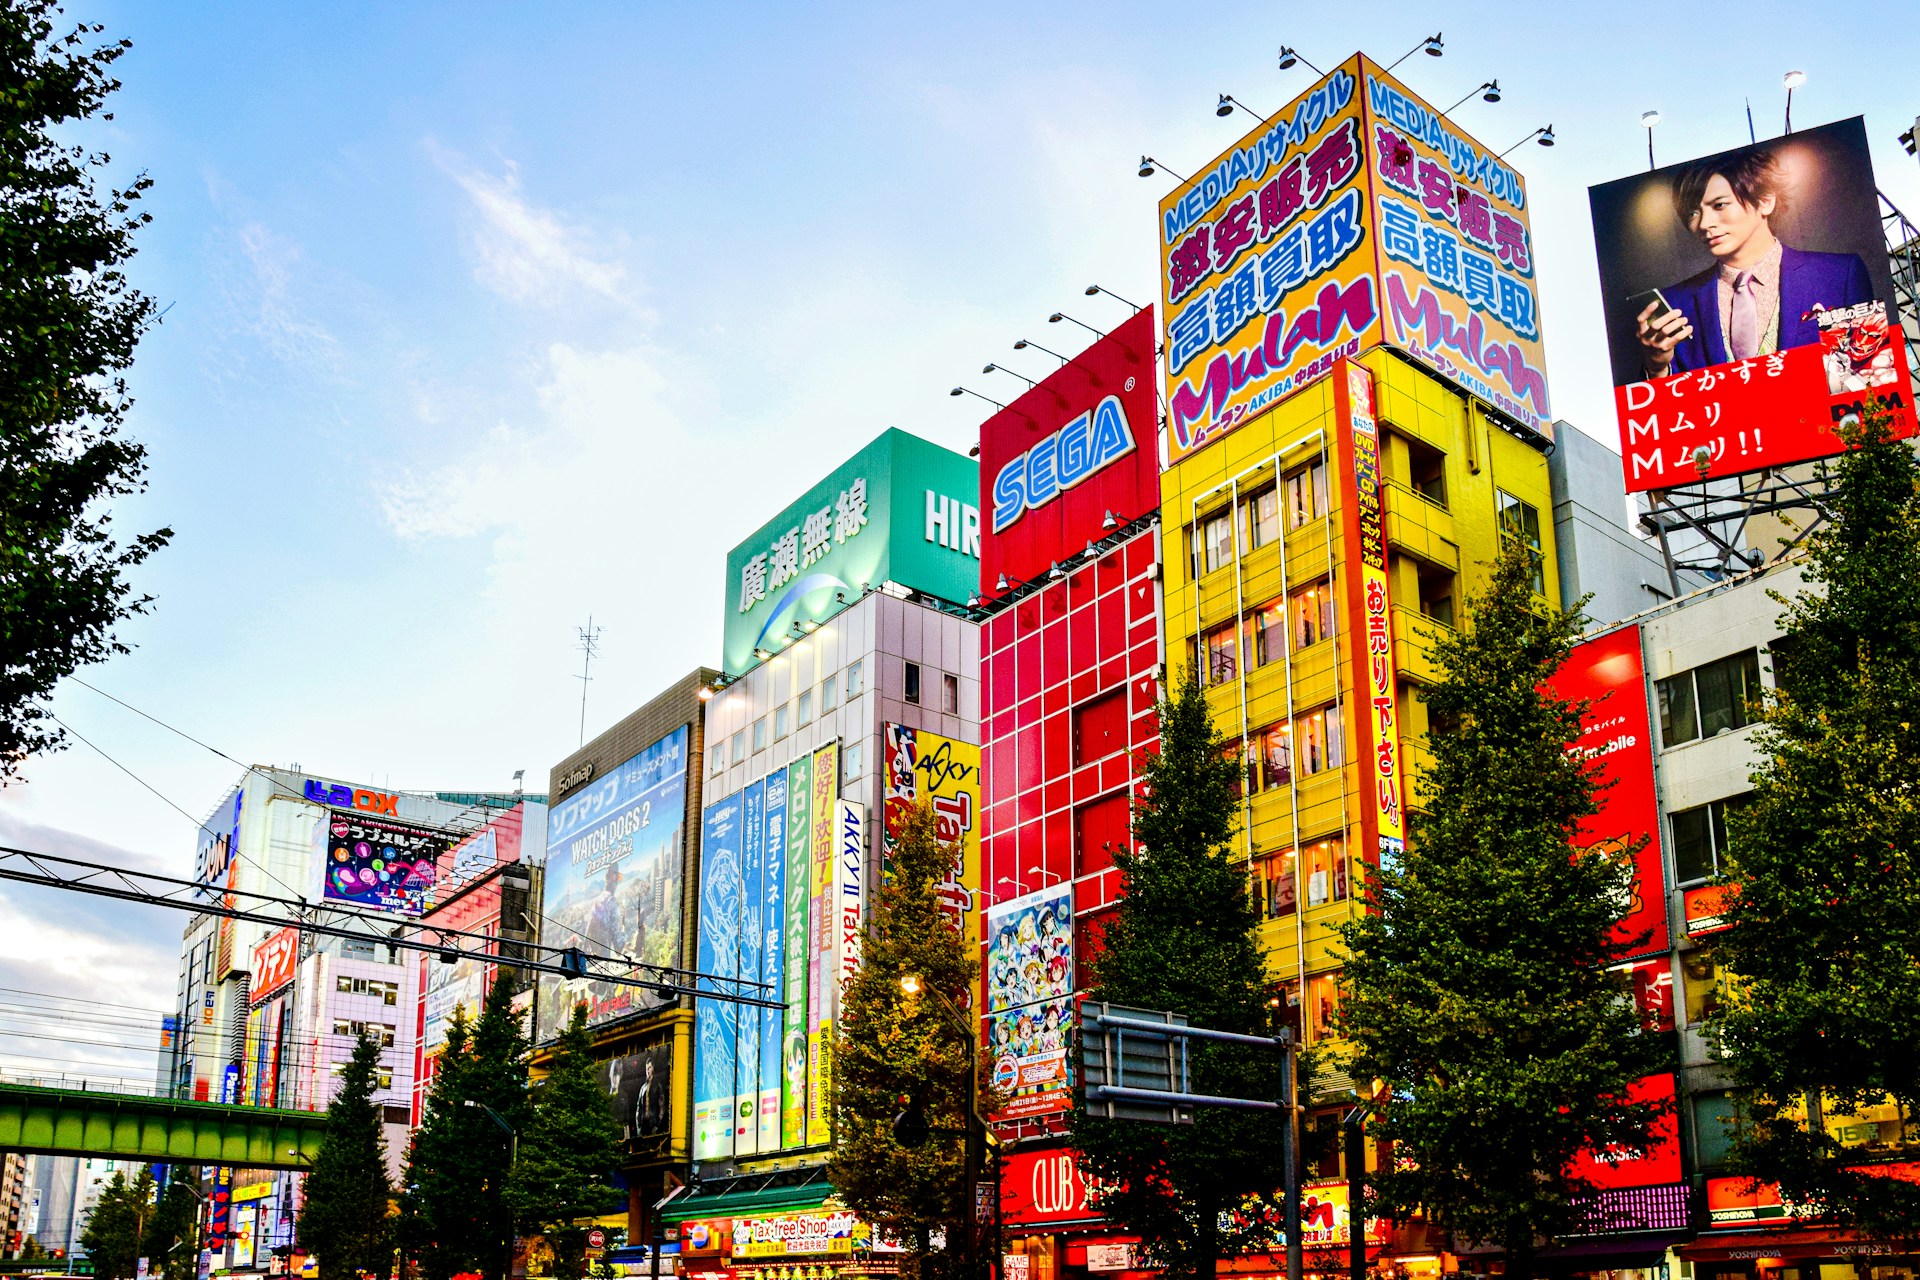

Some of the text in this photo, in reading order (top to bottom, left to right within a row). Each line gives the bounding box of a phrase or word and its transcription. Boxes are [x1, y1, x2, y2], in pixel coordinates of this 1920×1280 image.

[1164, 69, 1355, 244] MEDIAリサイクル
[1367, 73, 1525, 209] MEDIAリサイクル
[1168, 116, 1361, 303] 激安販売
[1373, 122, 1534, 278] 激安販売
[1168, 188, 1364, 375] 高額買取
[1378, 194, 1539, 342] 高額買取
[1817, 300, 1886, 327] 進撃の巨人
[1171, 273, 1378, 449] Mulan
[1386, 270, 1550, 418] Mulan
[1193, 337, 1360, 446] ムーラン AKIBA 中央通り店
[1409, 340, 1541, 432] ムーラン AKIBA 中央通り店
[1626, 350, 1788, 411] D でかすぎ
[1353, 417, 1374, 432] あなたの
[1355, 433, 1375, 452] DVD
[1628, 402, 1722, 445] M ムリ
[992, 394, 1136, 535] SEGA
[1355, 448, 1377, 466] ブルーレイ
[1356, 462, 1378, 481] ゲーム
[1632, 447, 1664, 479] M
[1358, 491, 1379, 508] アイドル
[1360, 476, 1375, 494] CD
[1359, 506, 1381, 524] アニメ
[1361, 521, 1381, 538] コミック
[739, 477, 869, 613] 廣瀬無線
[1363, 537, 1382, 552] ホビー
[1363, 551, 1383, 568] フィギュア
[558, 763, 593, 795] Sofmap
[553, 775, 619, 836] ソフマップ
[572, 800, 651, 865] WATCH DOGS 2
[844, 806, 860, 881] AKKY
[1032, 1156, 1074, 1213] CLUB
[753, 1222, 797, 1239] Tax-free
[799, 1218, 828, 1237] Shop
[1712, 1210, 1755, 1220] YOSHINOYA
[1004, 1255, 1028, 1267] GAME
[1729, 1249, 1782, 1259] YOSHINOYA
